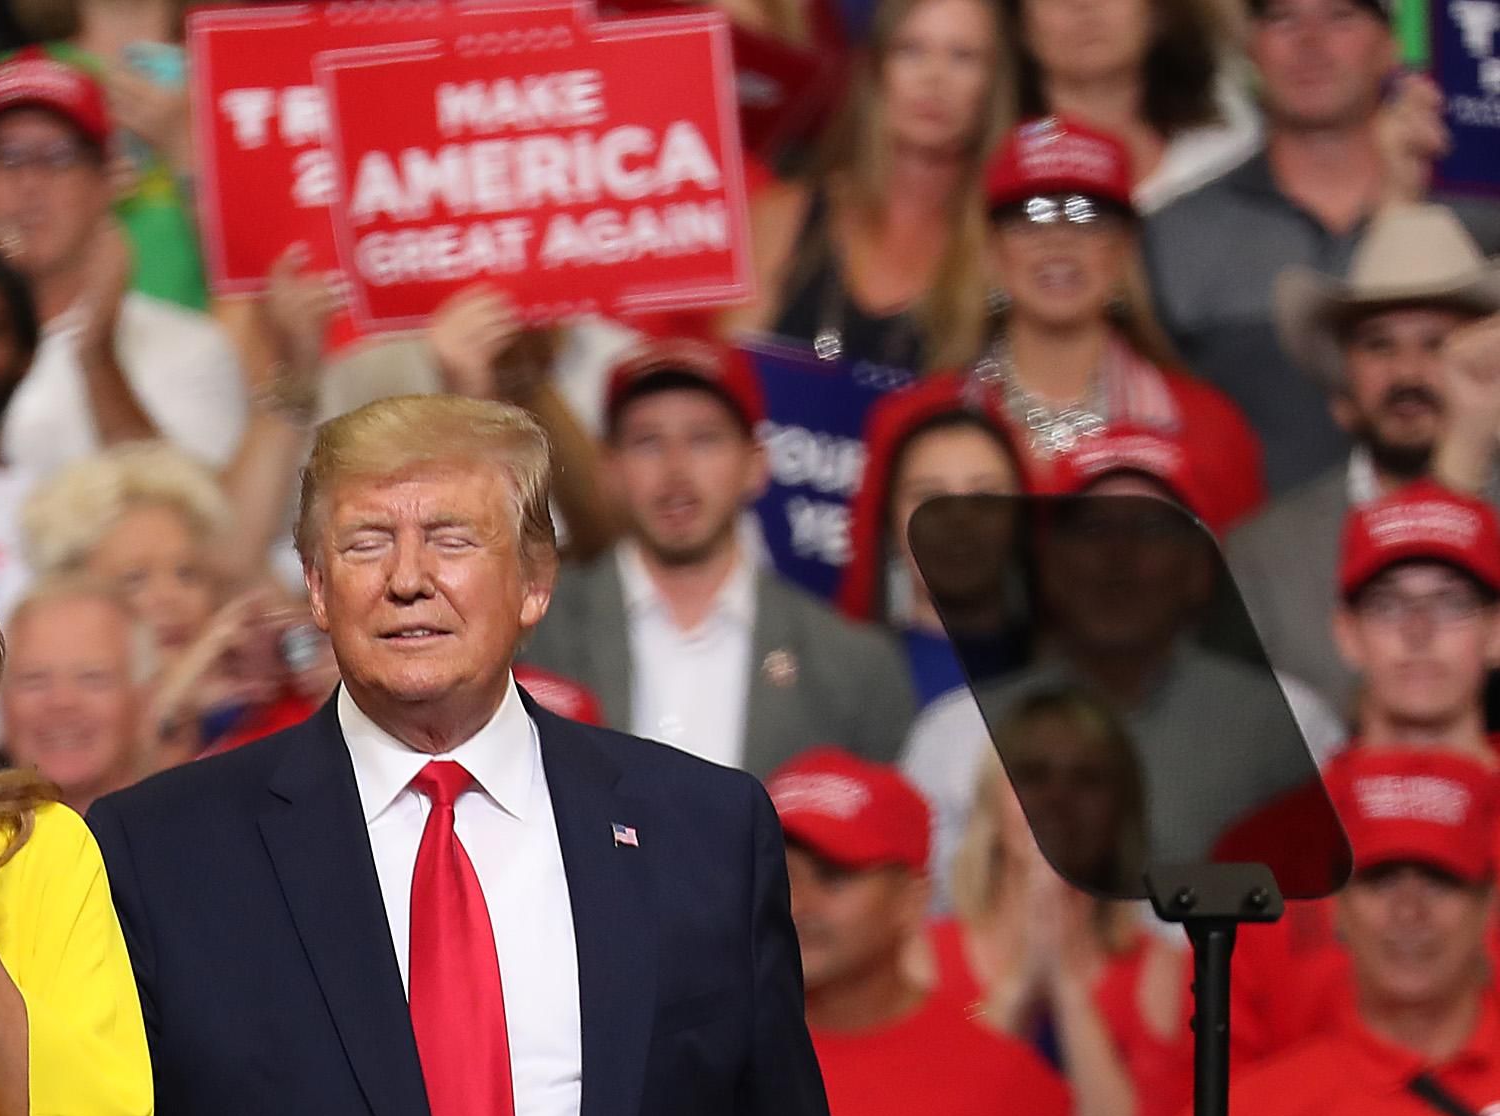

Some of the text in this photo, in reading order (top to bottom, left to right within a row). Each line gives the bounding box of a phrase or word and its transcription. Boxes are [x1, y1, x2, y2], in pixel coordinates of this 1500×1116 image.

[435, 68, 605, 137] MAKE
[350, 120, 722, 224] AMERICA
[355, 200, 732, 286] GREAT AGAIN
